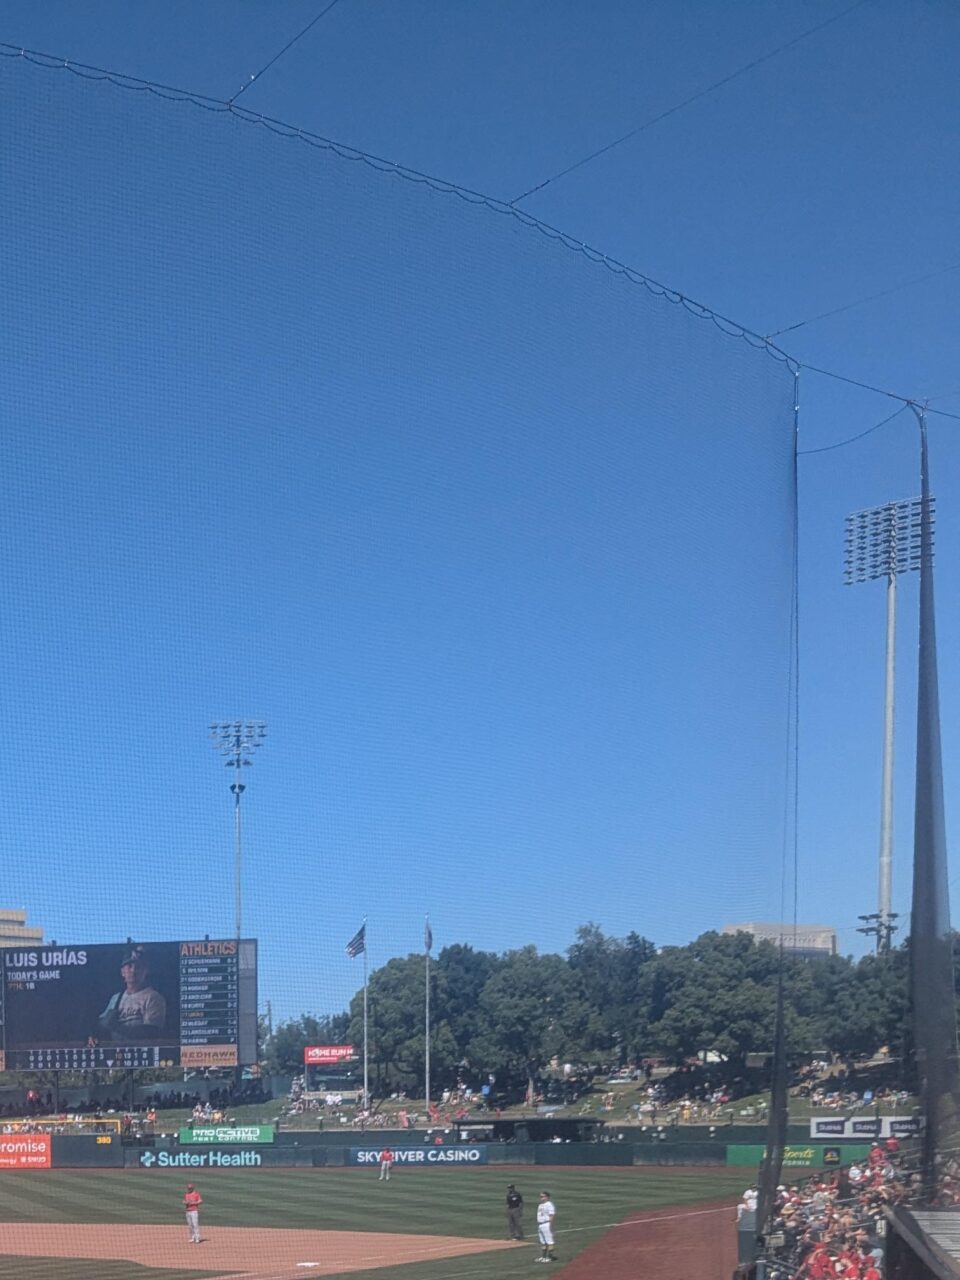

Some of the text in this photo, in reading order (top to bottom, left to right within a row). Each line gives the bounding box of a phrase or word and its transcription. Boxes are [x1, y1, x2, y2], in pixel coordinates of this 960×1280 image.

[181, 942, 236, 957] ATHLETICS
[6, 949, 87, 967] LUIS URÍAS
[7, 970, 60, 981] TODAY'S GAME
[181, 1051, 236, 1059] REDHAWK
[331, 1048, 346, 1056] RUN
[158, 1150, 261, 1166] Sutter Health
[357, 1151, 382, 1162] SKY
[427, 1149, 480, 1161] CASINO
